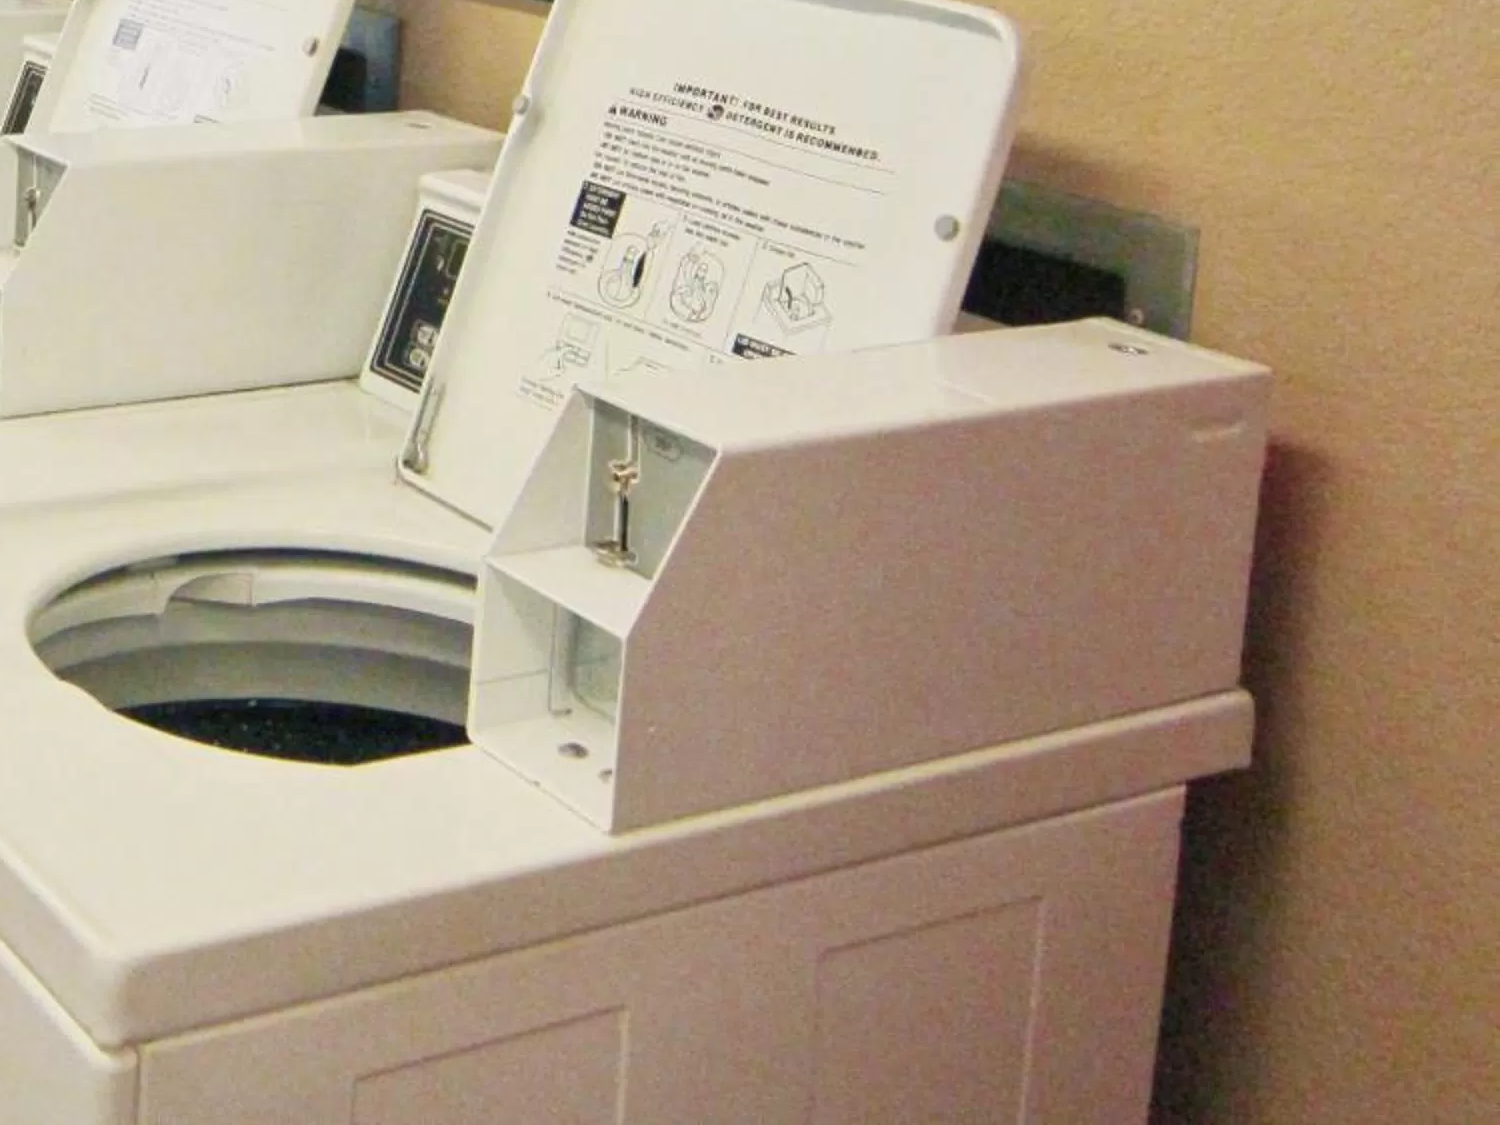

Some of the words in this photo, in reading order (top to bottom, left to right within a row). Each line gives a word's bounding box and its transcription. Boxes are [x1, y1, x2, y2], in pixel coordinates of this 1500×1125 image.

[619, 106, 667, 127] WARNING
[725, 110, 783, 136] DETERGENT
[743, 100, 762, 113] FOR
[763, 106, 789, 122] BEST
[790, 114, 836, 135] RESULTS
